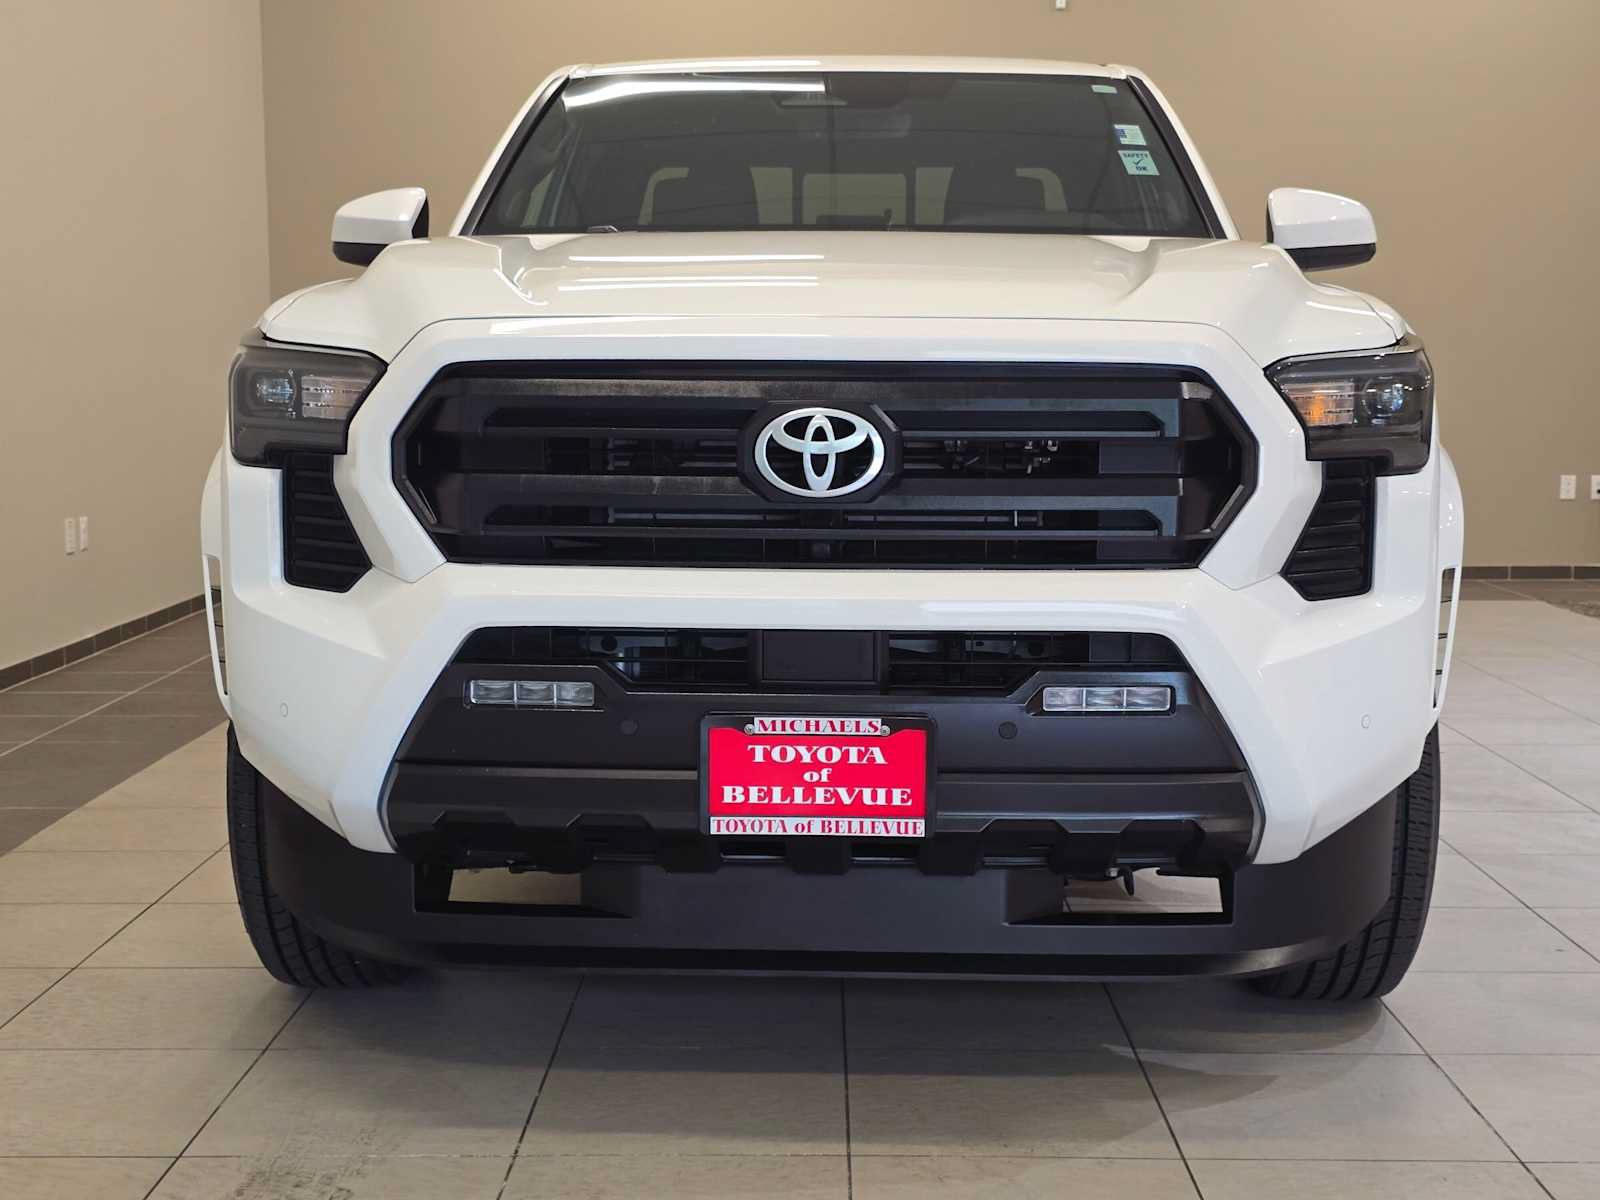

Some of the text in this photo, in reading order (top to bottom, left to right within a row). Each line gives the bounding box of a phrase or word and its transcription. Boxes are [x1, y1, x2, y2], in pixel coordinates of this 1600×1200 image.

[758, 719, 880, 733] MICHAELS
[747, 745, 888, 764] TOYOTA
[803, 768, 832, 782] of
[721, 786, 913, 806] BELLEVUE
[713, 819, 923, 835] TOYOTA of BELLEVUE
